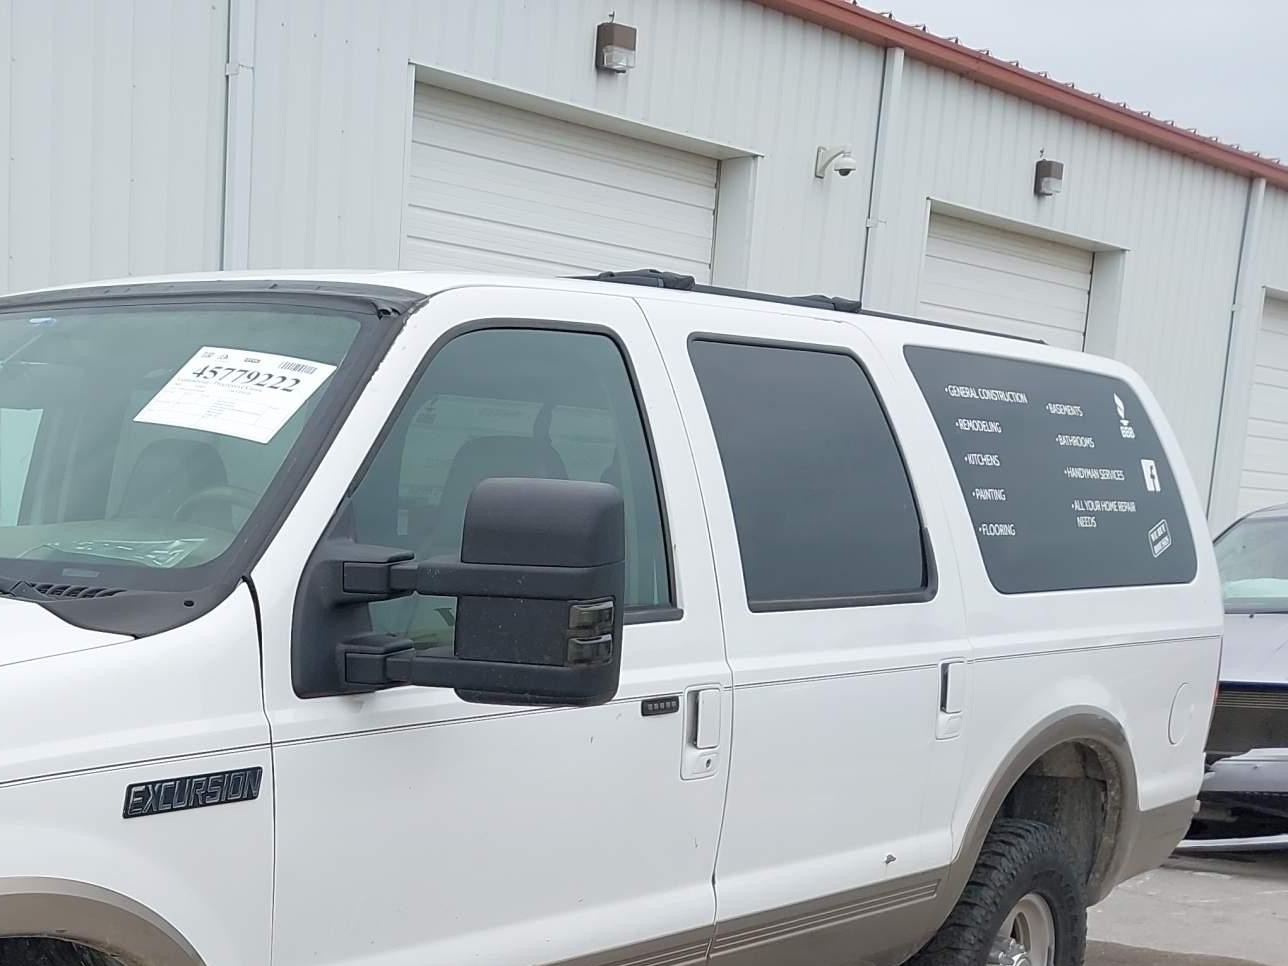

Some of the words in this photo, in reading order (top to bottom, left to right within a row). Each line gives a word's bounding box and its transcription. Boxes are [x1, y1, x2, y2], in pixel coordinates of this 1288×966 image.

[192, 364, 301, 392] 45779222
[948, 385, 979, 399] GENERAL
[978, 388, 1028, 404] CONSTRUCTION
[1048, 403, 1083, 417] BASEMENTS
[958, 418, 1002, 433] REMODELING
[1058, 434, 1095, 448] BATHROOMS
[968, 453, 1001, 467] KITCHENS
[1067, 467, 1100, 479] HANDYMAN
[1099, 469, 1125, 481] SERVICES
[975, 488, 1006, 501] PAINTING
[1074, 500, 1086, 511] ALL
[1084, 500, 1102, 511] YOUR
[1101, 501, 1119, 512] HOME
[1076, 516, 1097, 528] NEEDS
[982, 523, 1016, 536] FLOORING
[128, 768, 262, 816] EXCURSION
